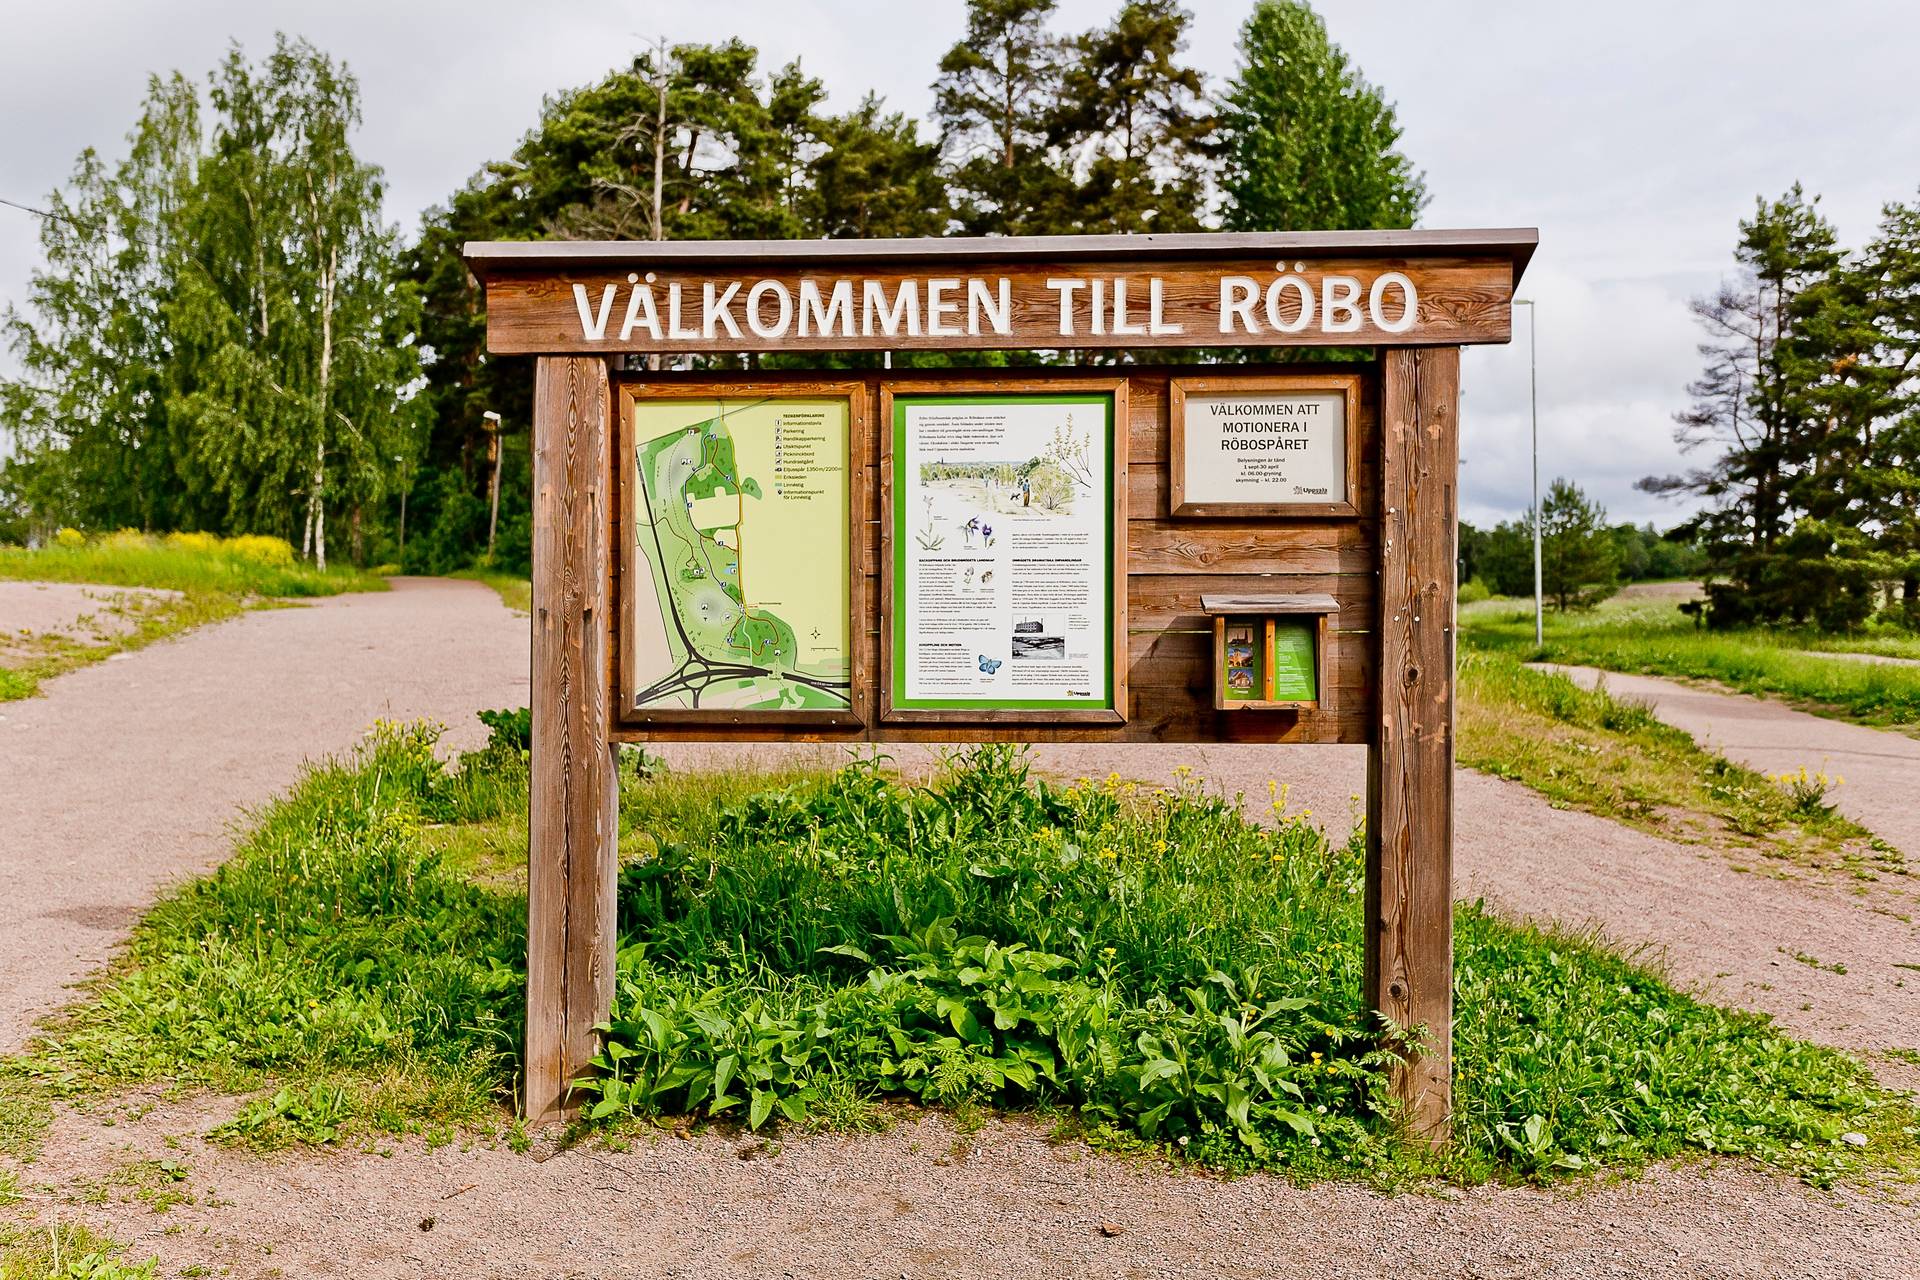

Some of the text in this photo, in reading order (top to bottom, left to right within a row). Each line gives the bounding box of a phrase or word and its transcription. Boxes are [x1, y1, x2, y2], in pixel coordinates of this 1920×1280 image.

[572, 260, 1419, 341] VÄLKOMMEN TILL RÖBO
[1210, 402, 1320, 416] VÄLKOMMEN ATT
[1222, 421, 1307, 433] MOTIONERA I
[1221, 436, 1309, 450] RÖBOSPÅRET
[1303, 487, 1328, 495] Uppsala
